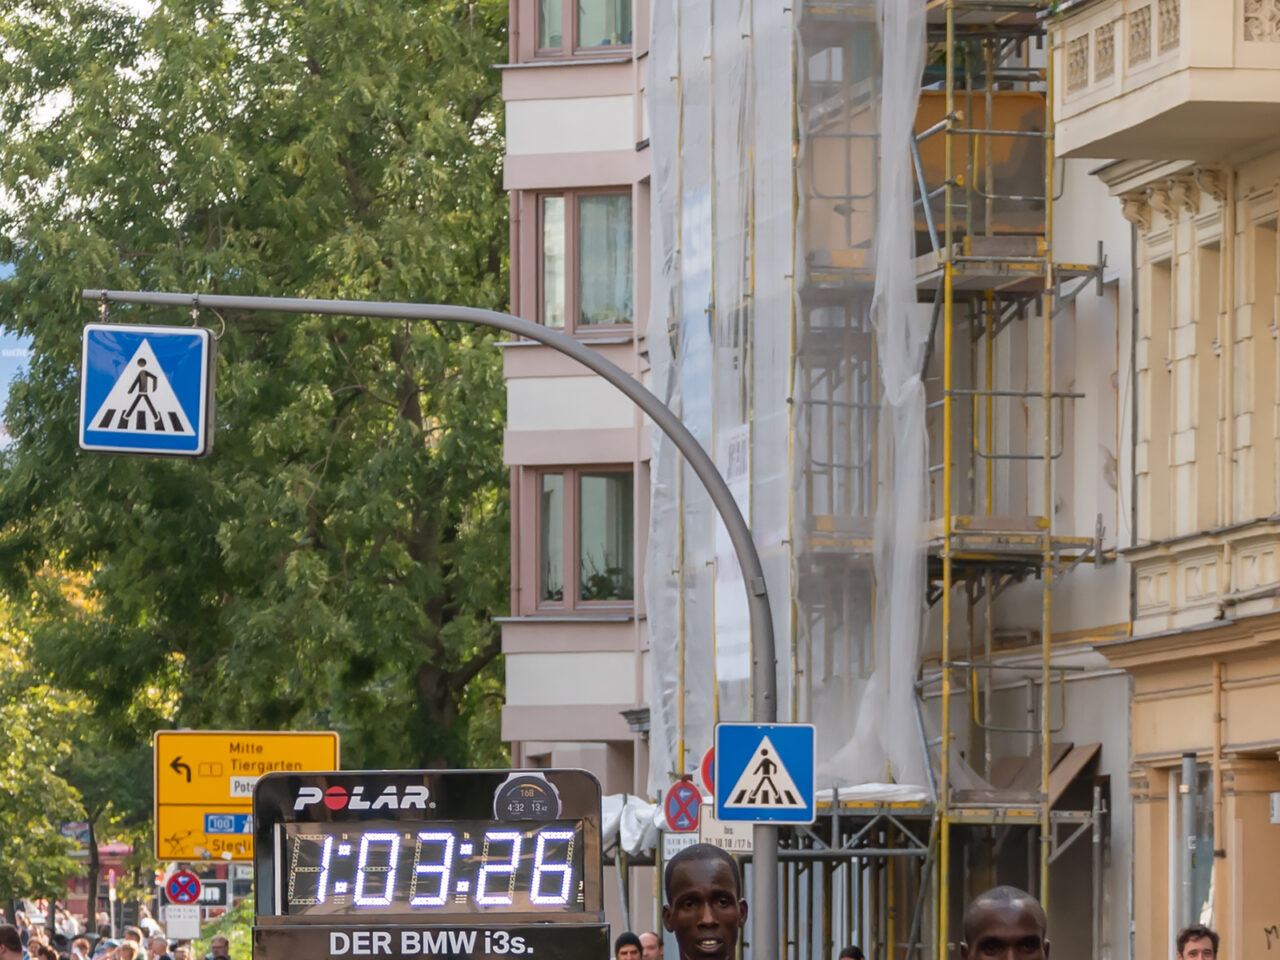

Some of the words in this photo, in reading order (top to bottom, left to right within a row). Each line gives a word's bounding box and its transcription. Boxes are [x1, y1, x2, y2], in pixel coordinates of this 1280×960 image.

[229, 742, 264, 755] Mitte
[230, 758, 303, 774] Tiergarten
[293, 785, 431, 811] POLAR
[212, 818, 230, 830] 100
[316, 831, 575, 907] 1:03:26
[329, 932, 393, 956] DER
[400, 931, 477, 956] BMW
